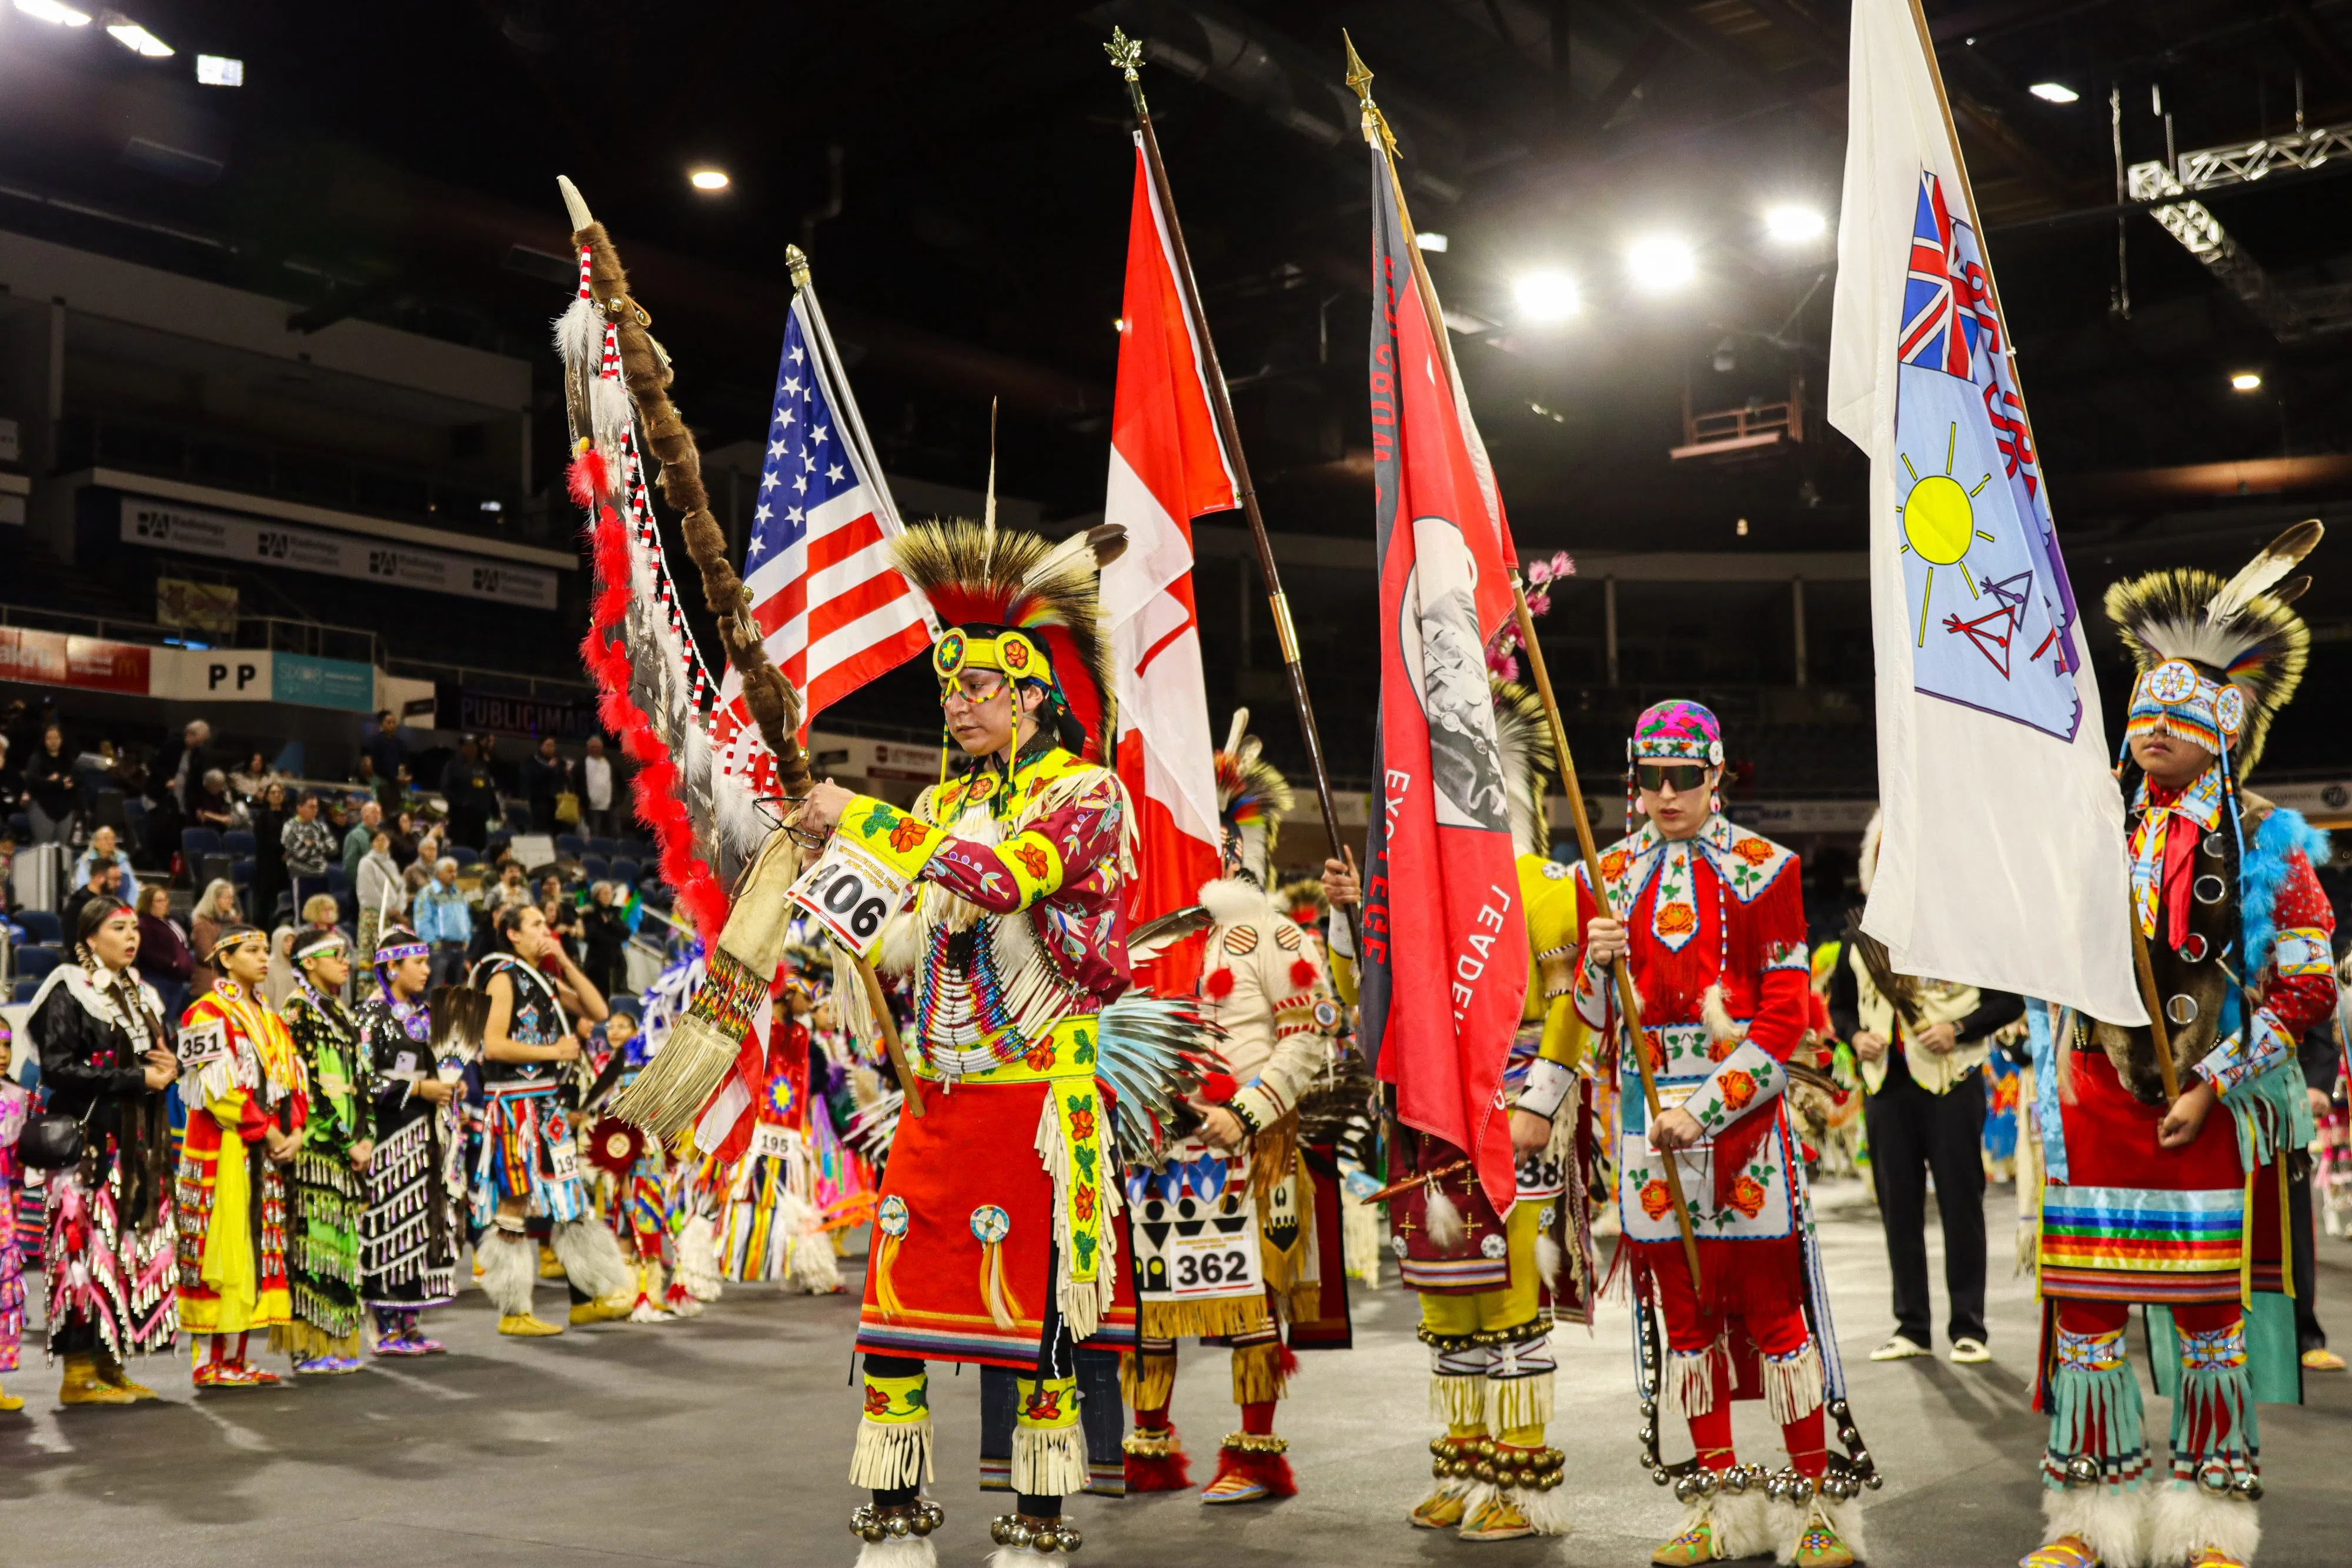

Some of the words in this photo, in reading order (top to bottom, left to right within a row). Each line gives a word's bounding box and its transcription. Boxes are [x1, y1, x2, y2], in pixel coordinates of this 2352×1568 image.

[804, 864, 887, 938] 406
[182, 1032, 221, 1058] 351
[762, 1134, 789, 1153] 195
[1178, 1251, 1248, 1286] 362
